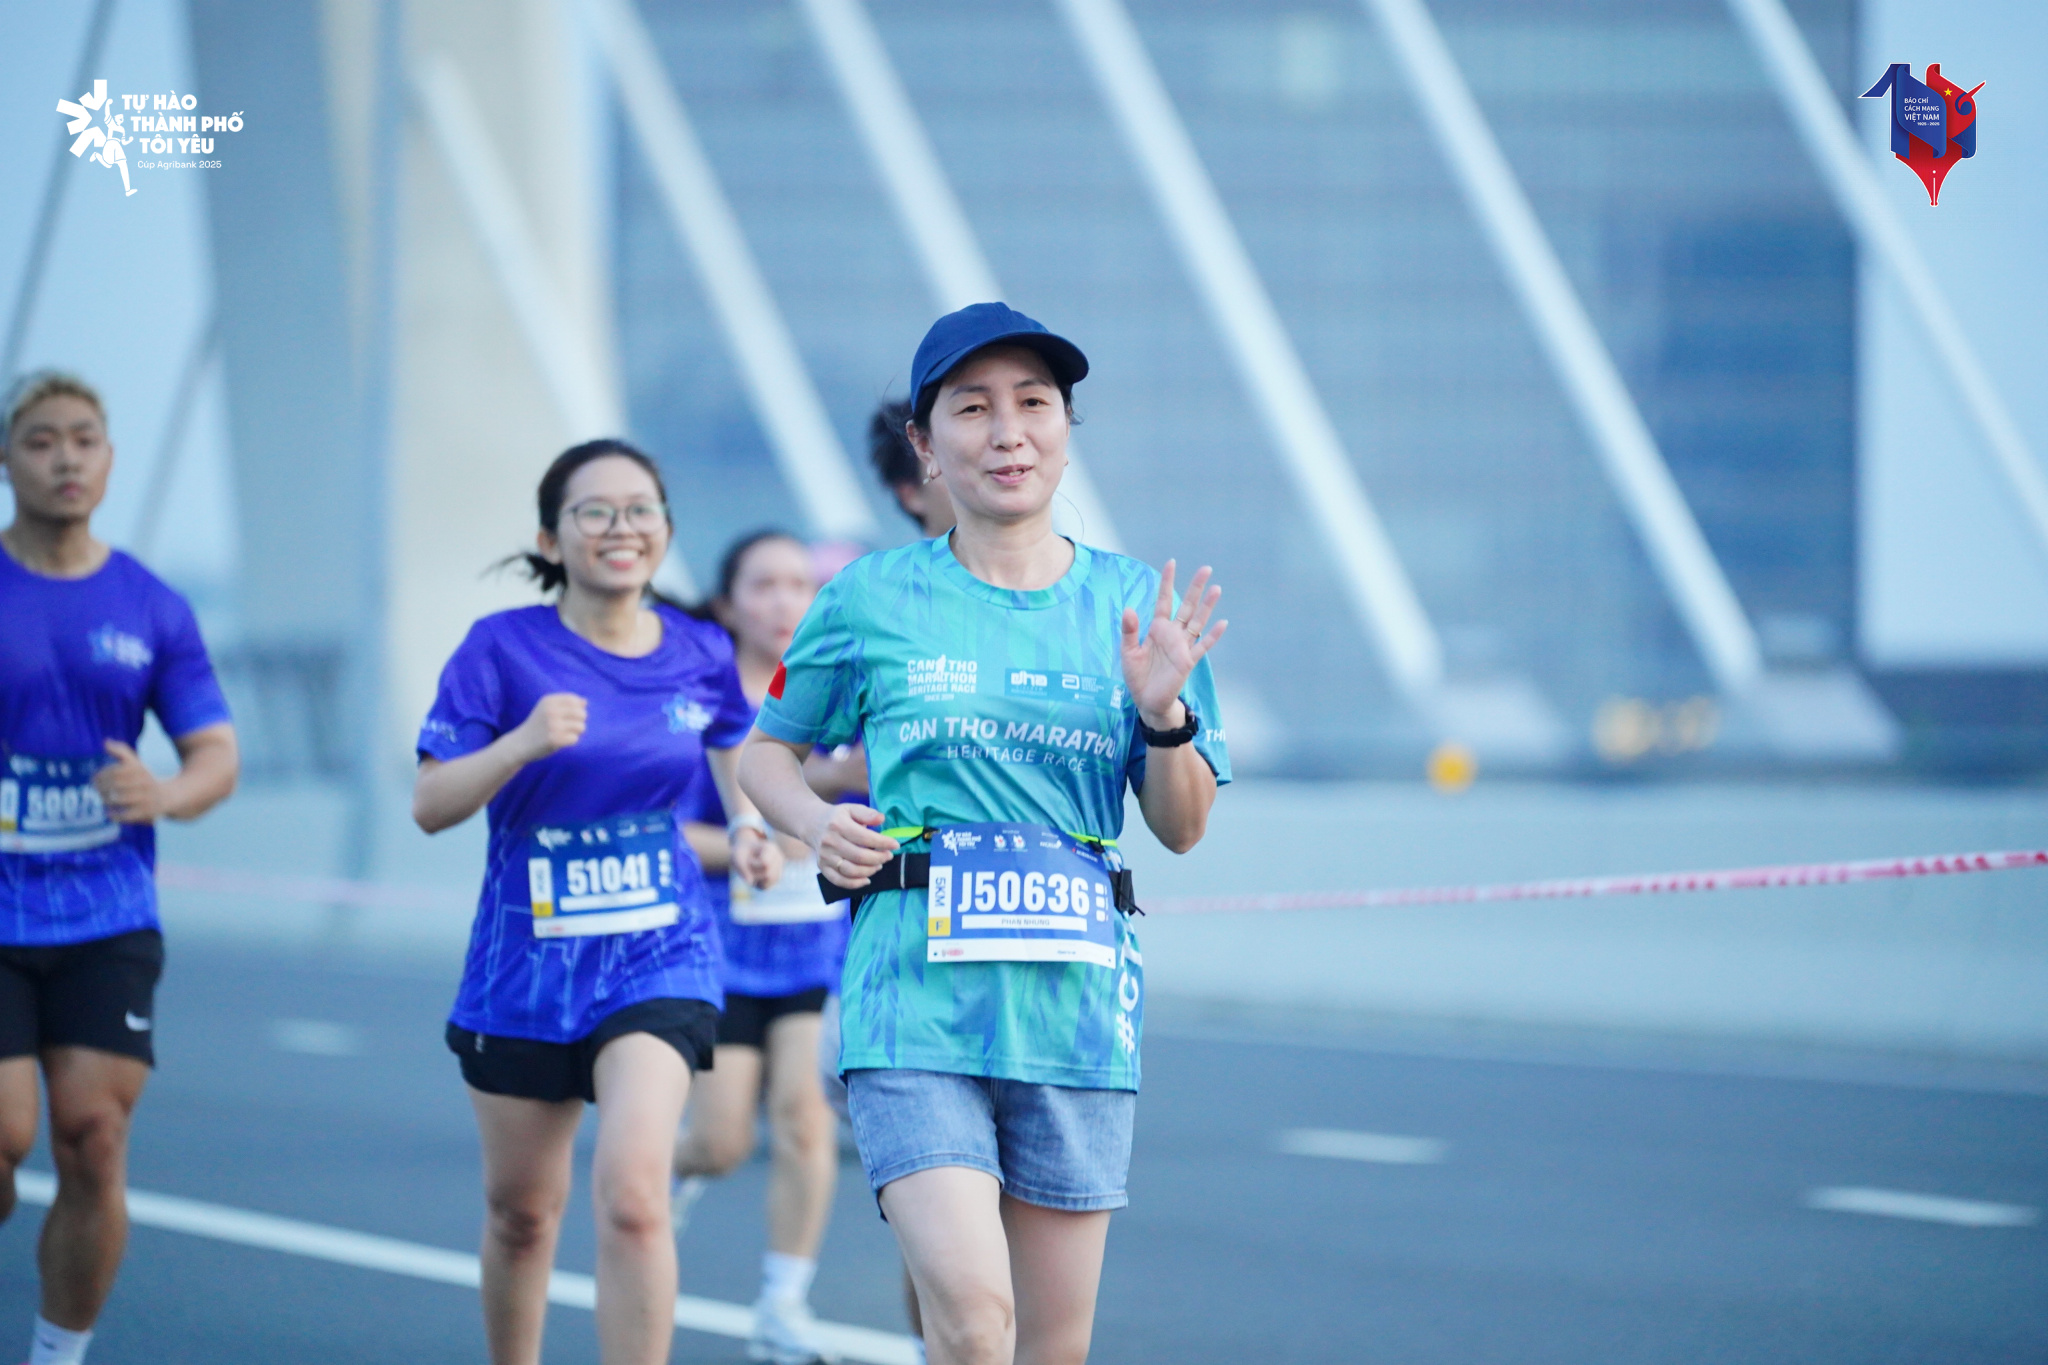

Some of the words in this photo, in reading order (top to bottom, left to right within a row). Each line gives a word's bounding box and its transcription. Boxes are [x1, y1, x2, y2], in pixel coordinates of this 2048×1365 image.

[907, 659, 936, 673] CAN
[948, 660, 978, 673] THO
[907, 671, 977, 686] MARATHON
[908, 683, 948, 697] HERITAGE
[950, 683, 977, 694] RACE
[899, 717, 937, 743] CAN
[944, 717, 999, 740] THO
[1004, 721, 1117, 760] MARATHO
[946, 744, 1037, 763] HERITAGE
[1043, 751, 1088, 772] RACE
[567, 852, 650, 896] 51041
[935, 877, 946, 907] 5KM
[957, 870, 1091, 917] J50636
[1001, 918, 1022, 926] PHAN
[1023, 918, 1051, 927] NHUNG
